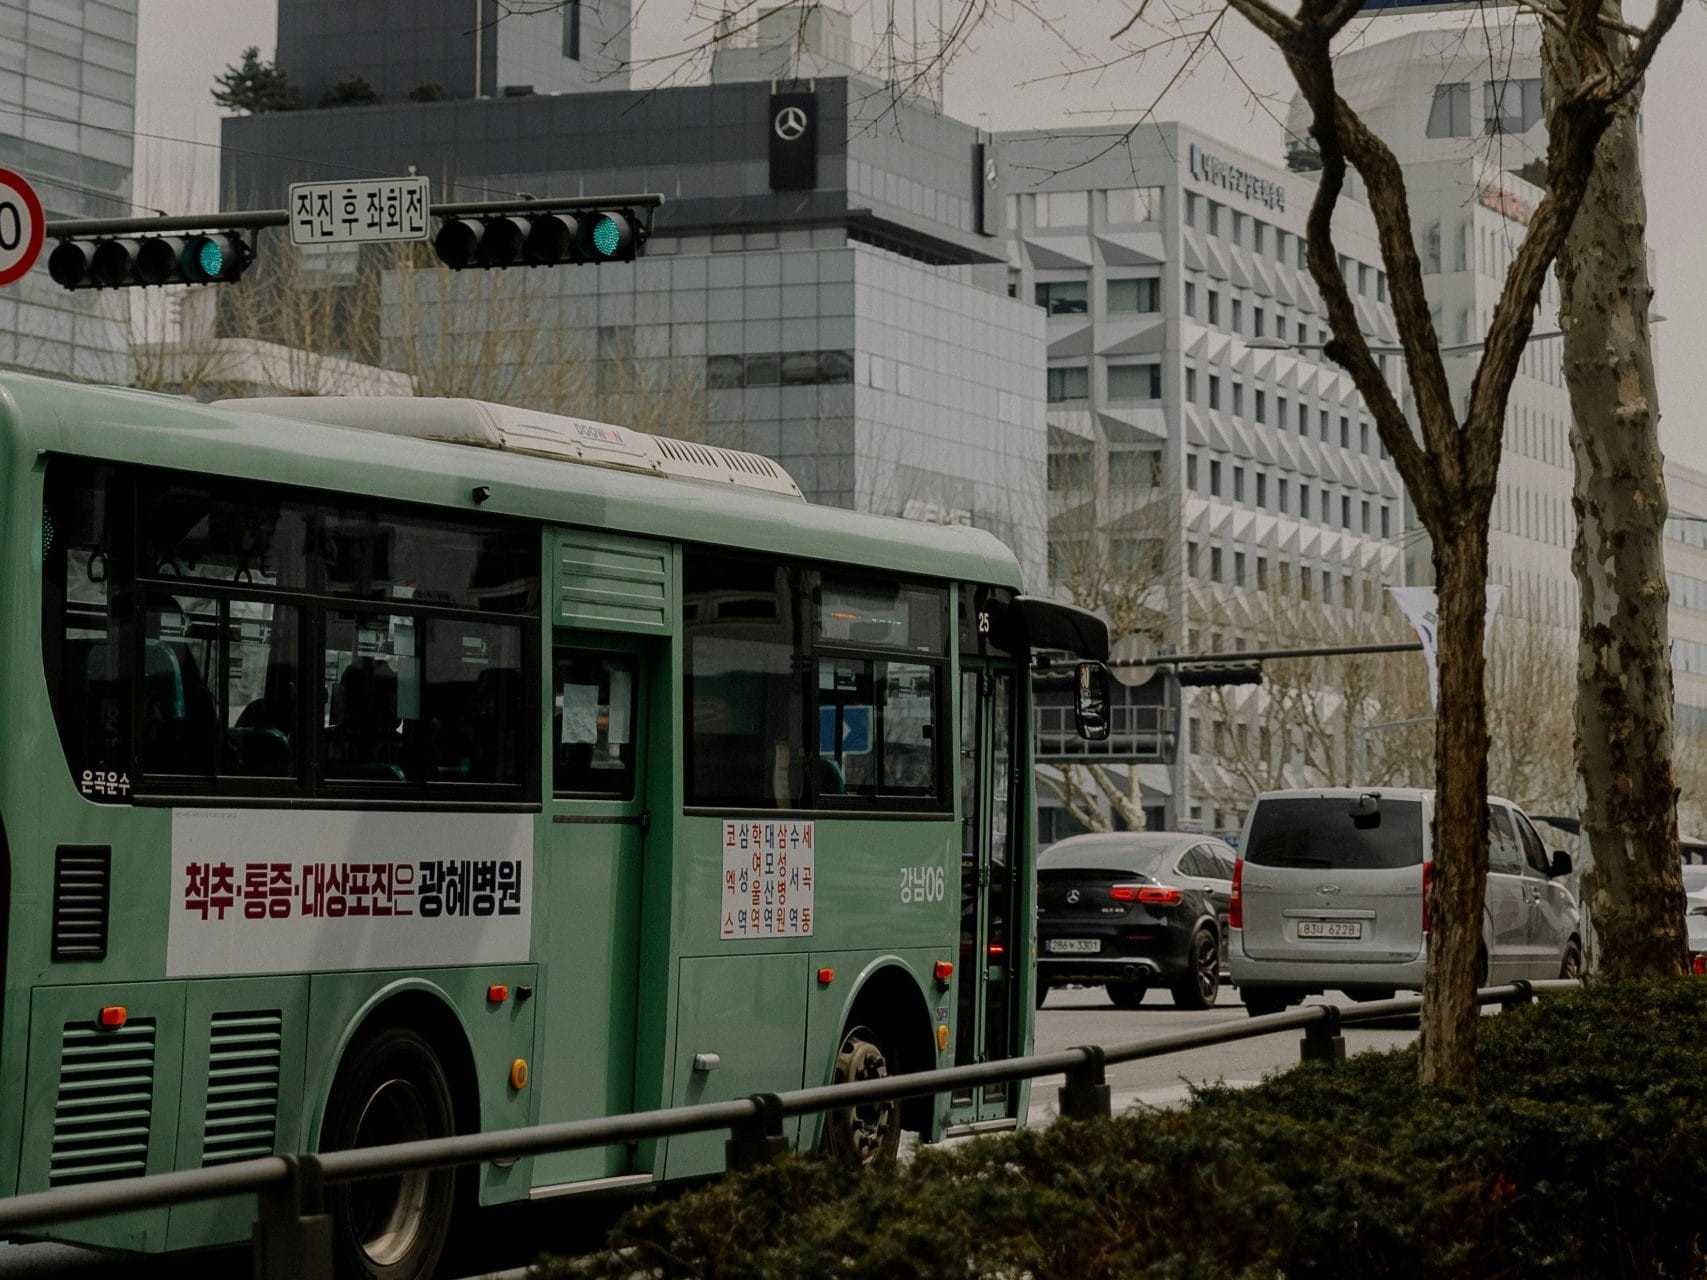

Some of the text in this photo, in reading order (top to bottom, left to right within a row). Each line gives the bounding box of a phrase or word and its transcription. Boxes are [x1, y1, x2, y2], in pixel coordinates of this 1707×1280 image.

[297, 185, 424, 238] 직진 후 좌회전
[977, 612, 990, 633] 25
[81, 769, 131, 797] 은곡운수
[418, 860, 522, 918] 광혜병원
[900, 866, 945, 904] 강남06
[1328, 924, 1356, 936] 6228
